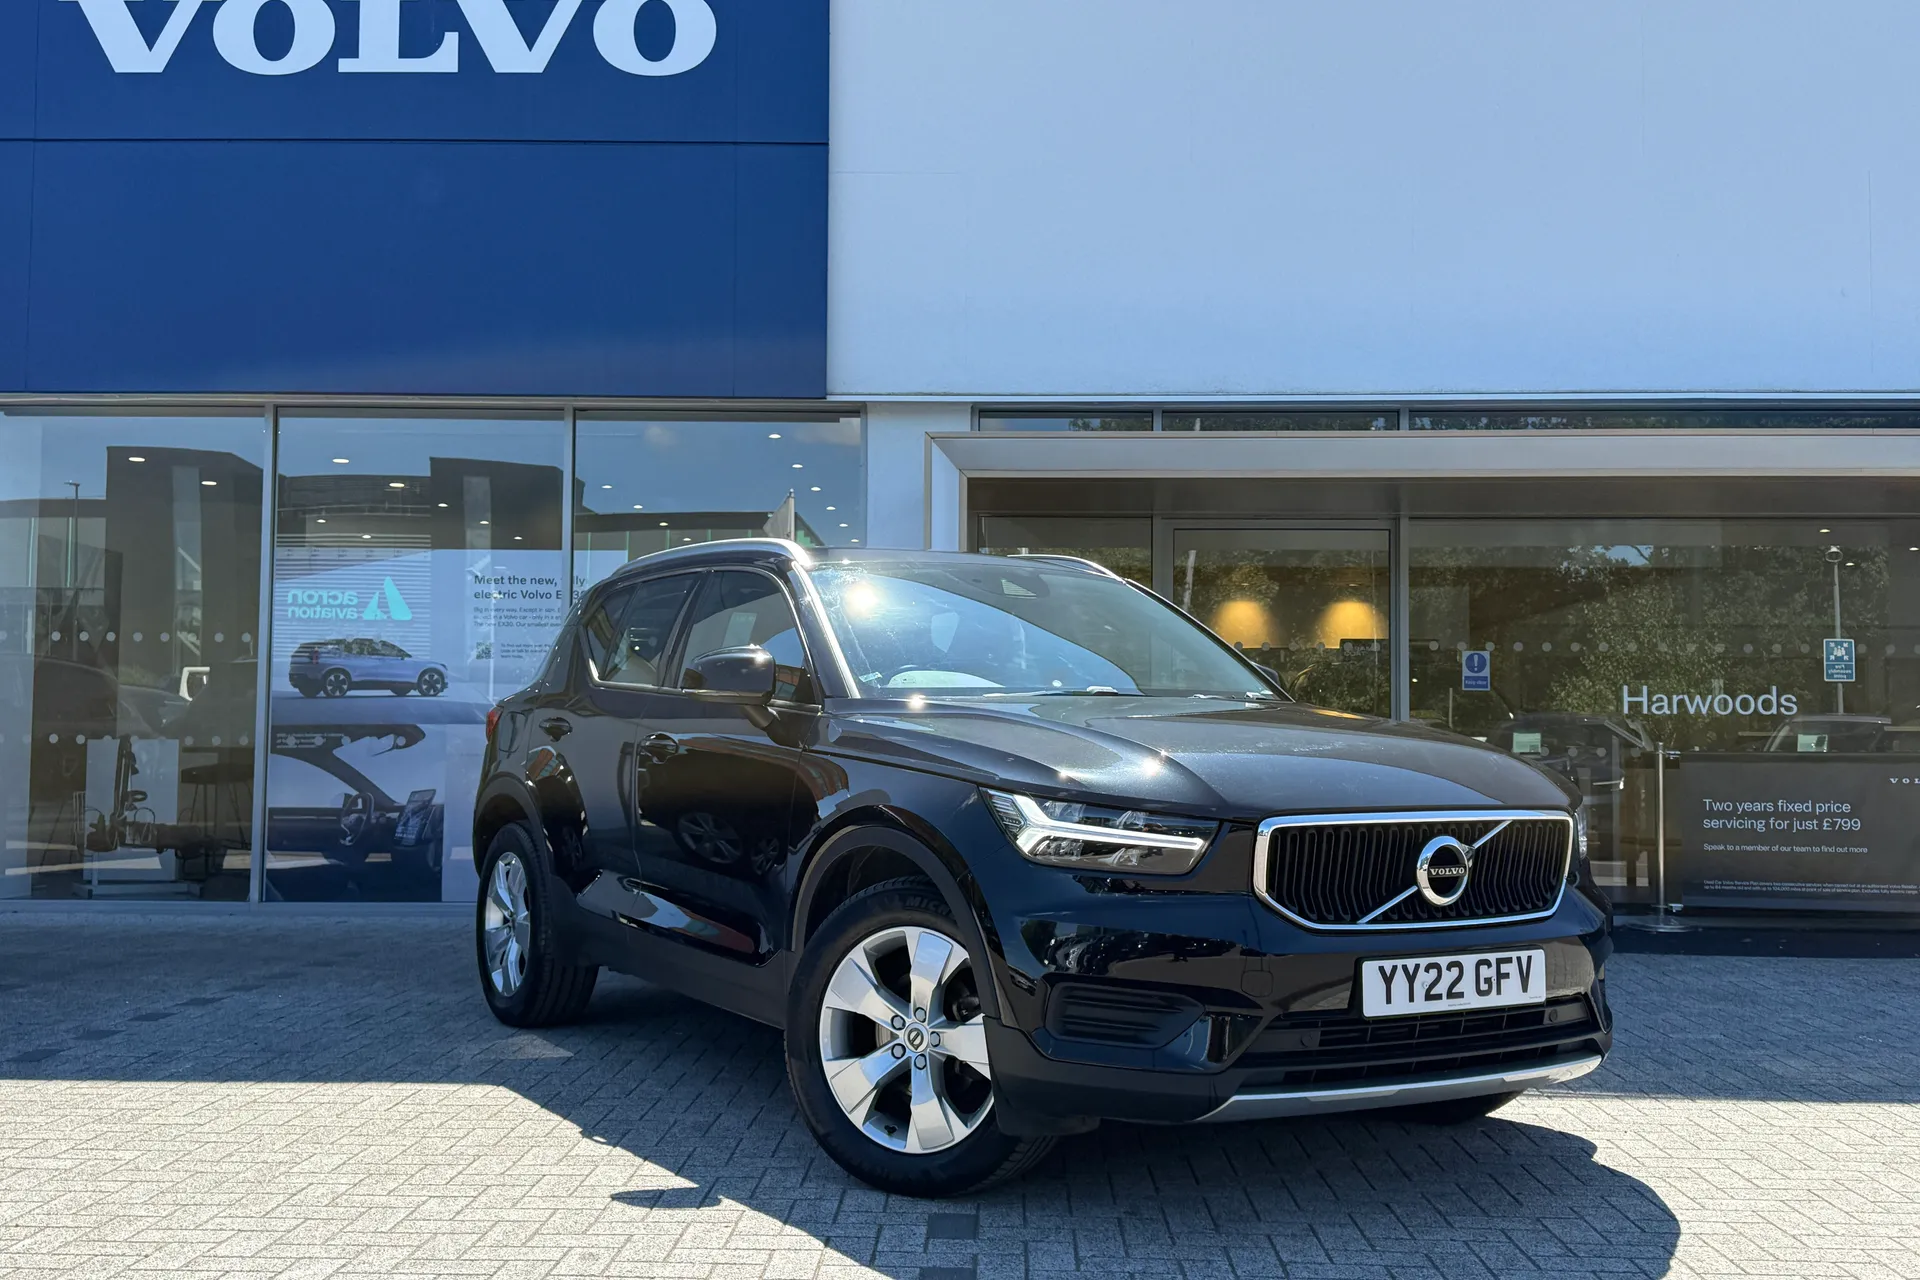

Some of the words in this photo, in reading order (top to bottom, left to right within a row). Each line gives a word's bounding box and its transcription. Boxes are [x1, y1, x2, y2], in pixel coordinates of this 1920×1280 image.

[58, 0, 717, 76] VOLVO
[474, 575, 504, 585] Meet
[508, 575, 527, 585] the
[530, 577, 558, 587] new,
[520, 590, 552, 600] Volvo
[1623, 685, 1798, 715] Harwoods
[1703, 798, 1733, 812] Two
[1736, 801, 1774, 815] years
[1777, 799, 1812, 813] fixed
[1816, 800, 1851, 816] price
[1703, 816, 1766, 832] servicing
[1768, 817, 1790, 830] for
[1792, 817, 1819, 833] just
[1822, 818, 1861, 831] £799
[1703, 843, 1726, 852] Speak
[1740, 844, 1770, 852] member
[1771, 844, 1779, 852] of
[1821, 845, 1836, 853] find
[1430, 867, 1465, 876] VOLVO
[1378, 960, 1465, 1004] YY22
[1474, 955, 1533, 997] GFV
